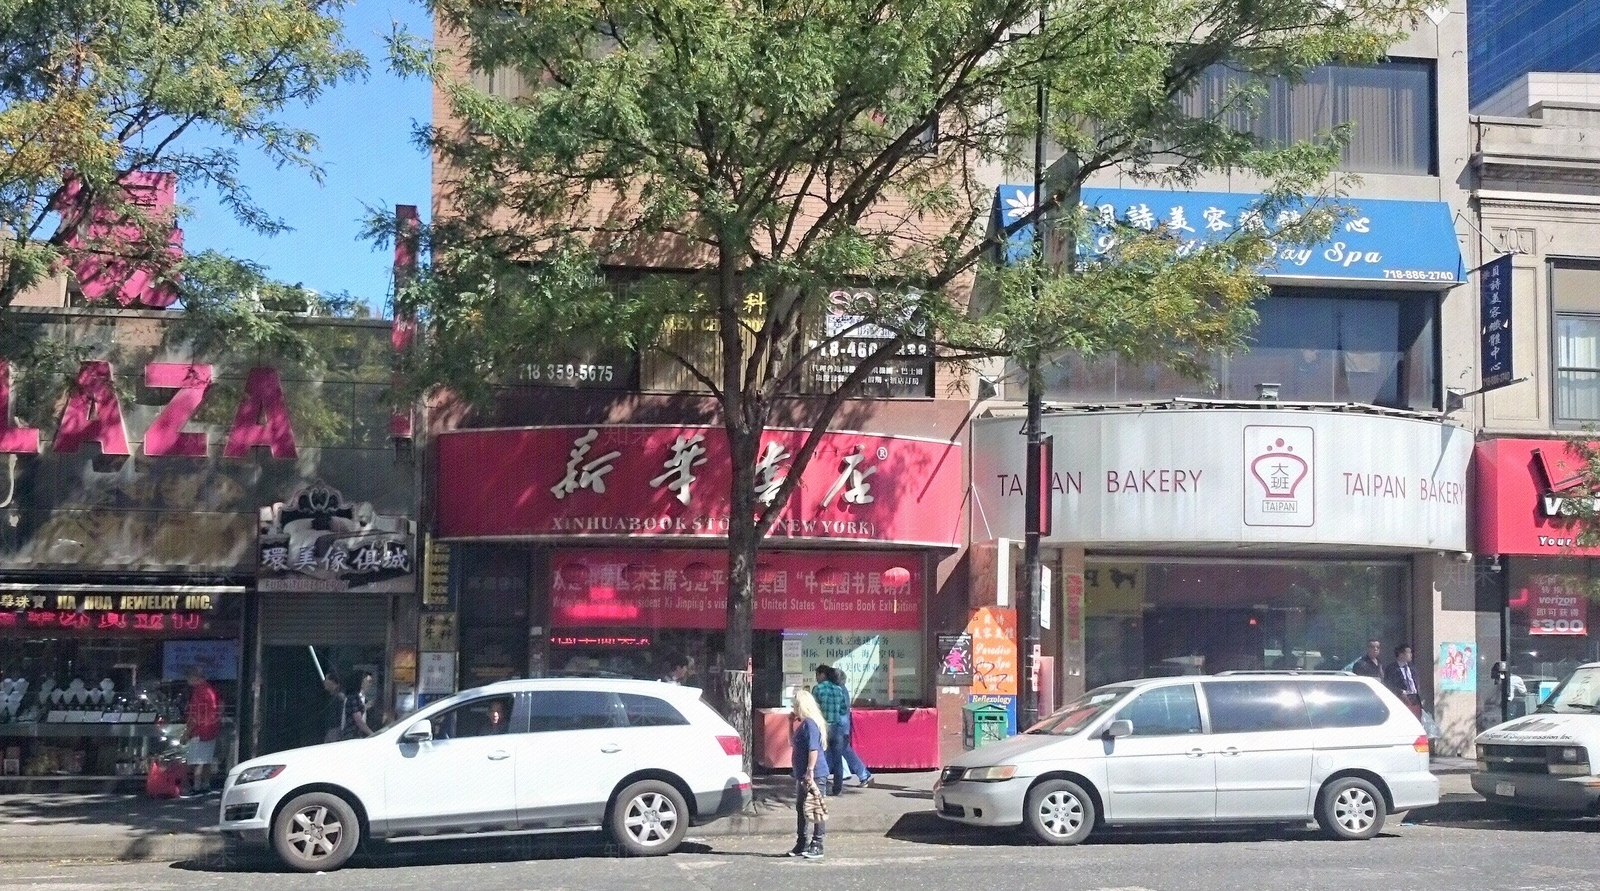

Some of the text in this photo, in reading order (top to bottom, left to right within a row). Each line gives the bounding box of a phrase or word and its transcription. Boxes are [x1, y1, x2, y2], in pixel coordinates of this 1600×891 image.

[1324, 242, 1382, 267] Spa
[1383, 269, 1454, 281] 718-886-2740
[547, 364, 613, 381] 359-5675
[997, 469, 1203, 497] TAAN BAKERY
[1343, 472, 1464, 505] TAIPAN BAKERY
[1265, 502, 1296, 512] TAIPAN
[821, 519, 875, 535] YORK)
[1539, 535, 1572, 547] Your
[57, 595, 214, 610] JIA HUA JEWELRY INC.
[761, 598, 787, 609] United
[790, 598, 815, 610] States
[856, 600, 876, 611] Book
[880, 600, 918, 612] Exhbition
[1539, 595, 1577, 606] verizon
[1532, 618, 1584, 632] $300
[972, 694, 1012, 705] Reflexology
